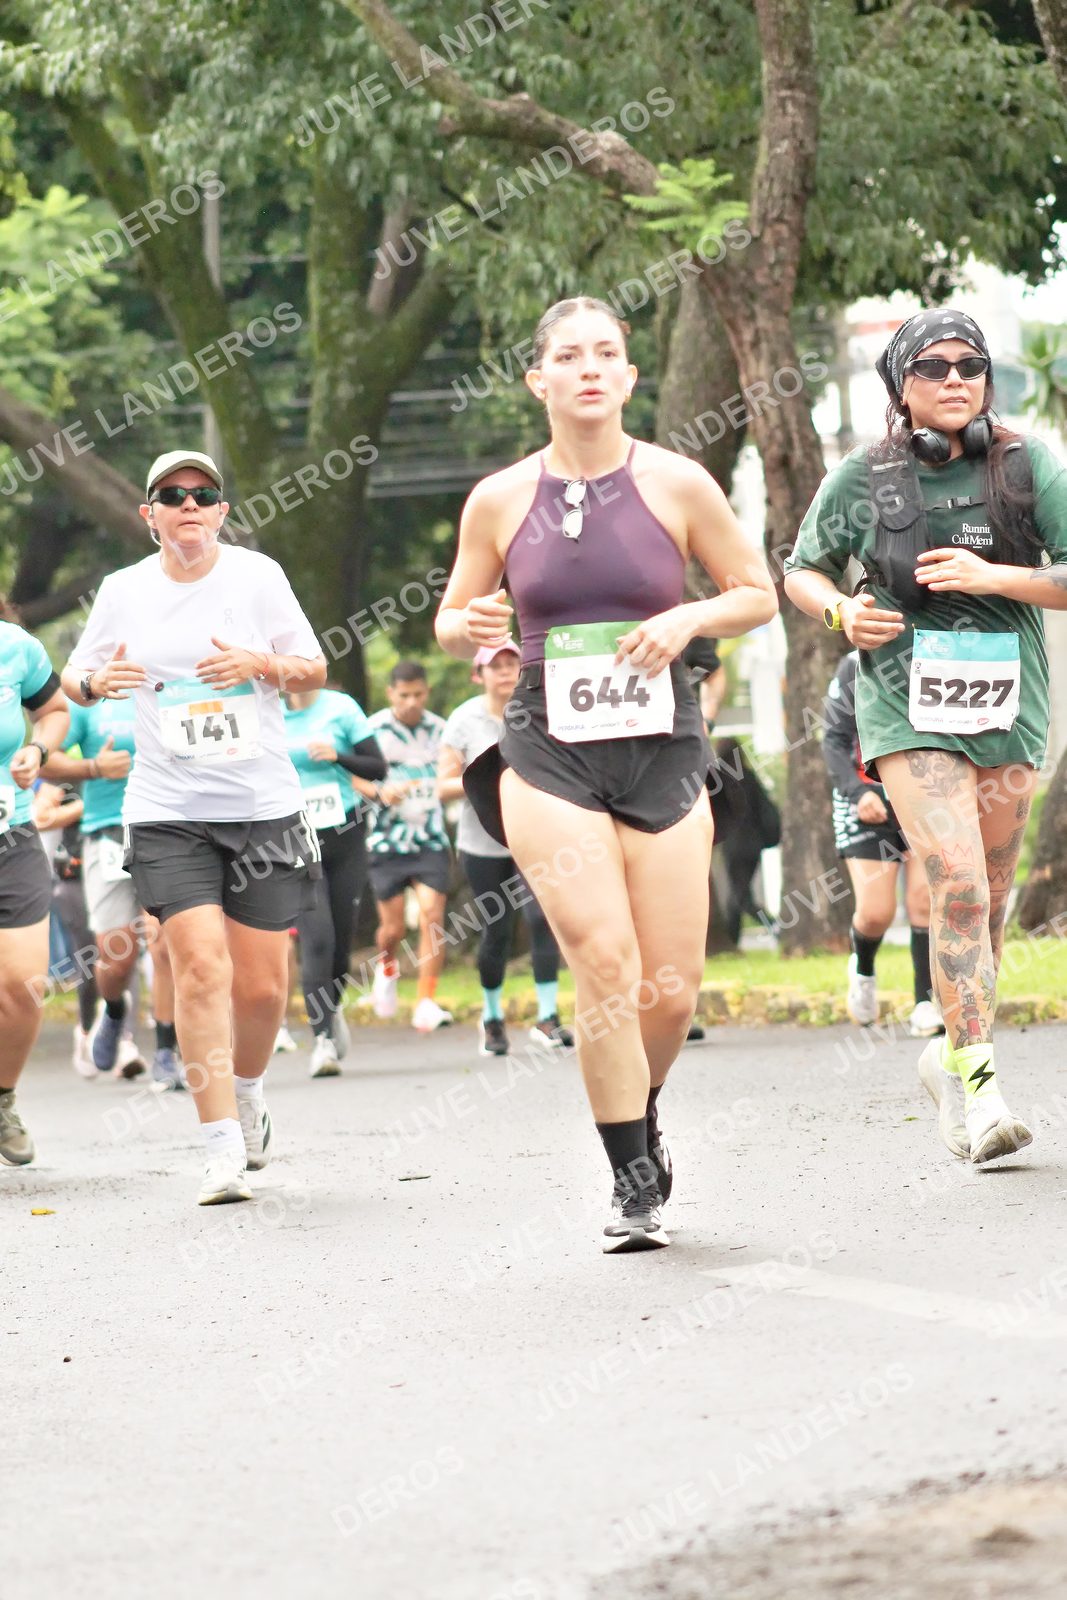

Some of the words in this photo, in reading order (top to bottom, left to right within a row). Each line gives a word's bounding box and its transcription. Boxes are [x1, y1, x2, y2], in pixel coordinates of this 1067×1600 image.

[569, 675, 651, 712] 644
[918, 677, 1015, 709] 5227
[181, 713, 240, 745] 141
[305, 795, 336, 813] 79
